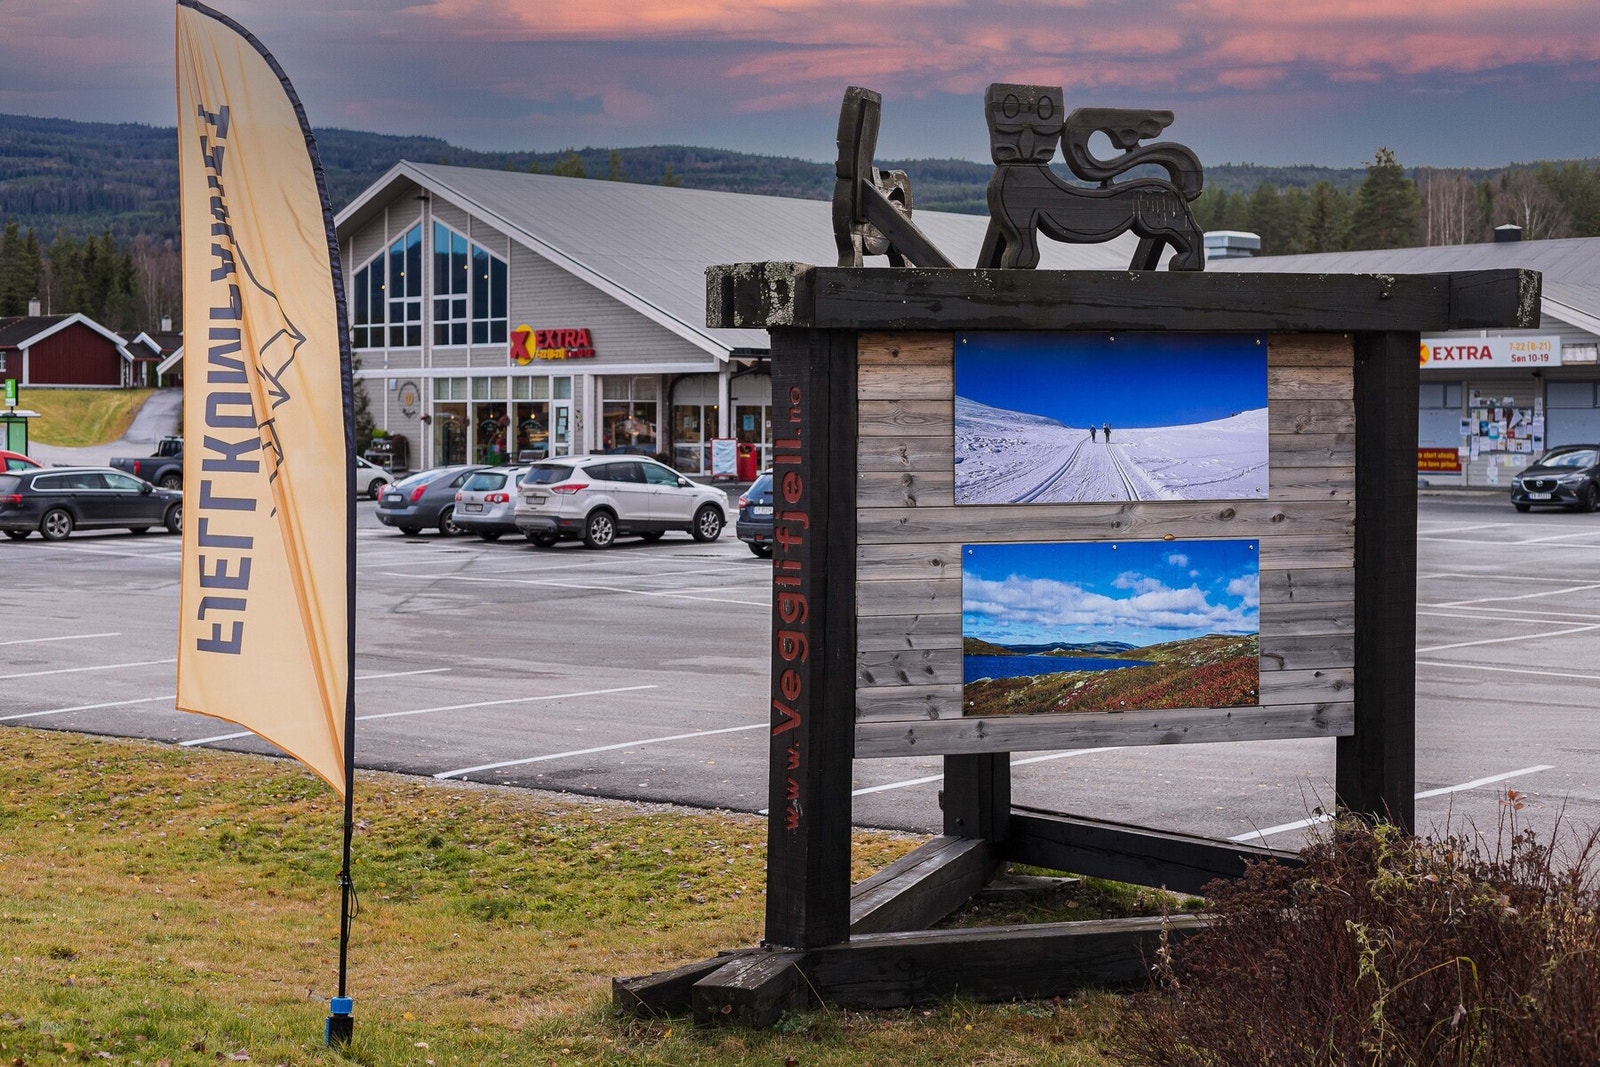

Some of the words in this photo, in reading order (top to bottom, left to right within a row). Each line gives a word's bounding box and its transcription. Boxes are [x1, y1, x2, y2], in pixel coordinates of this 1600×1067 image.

[535, 328, 591, 348] EXTRA
[1432, 345, 1493, 361] EXTRA
[1509, 342, 1525, 351] 7-22
[1527, 341, 1551, 352] (8-21)
[1511, 354, 1526, 363] Søn
[1528, 353, 1549, 362] 10-19
